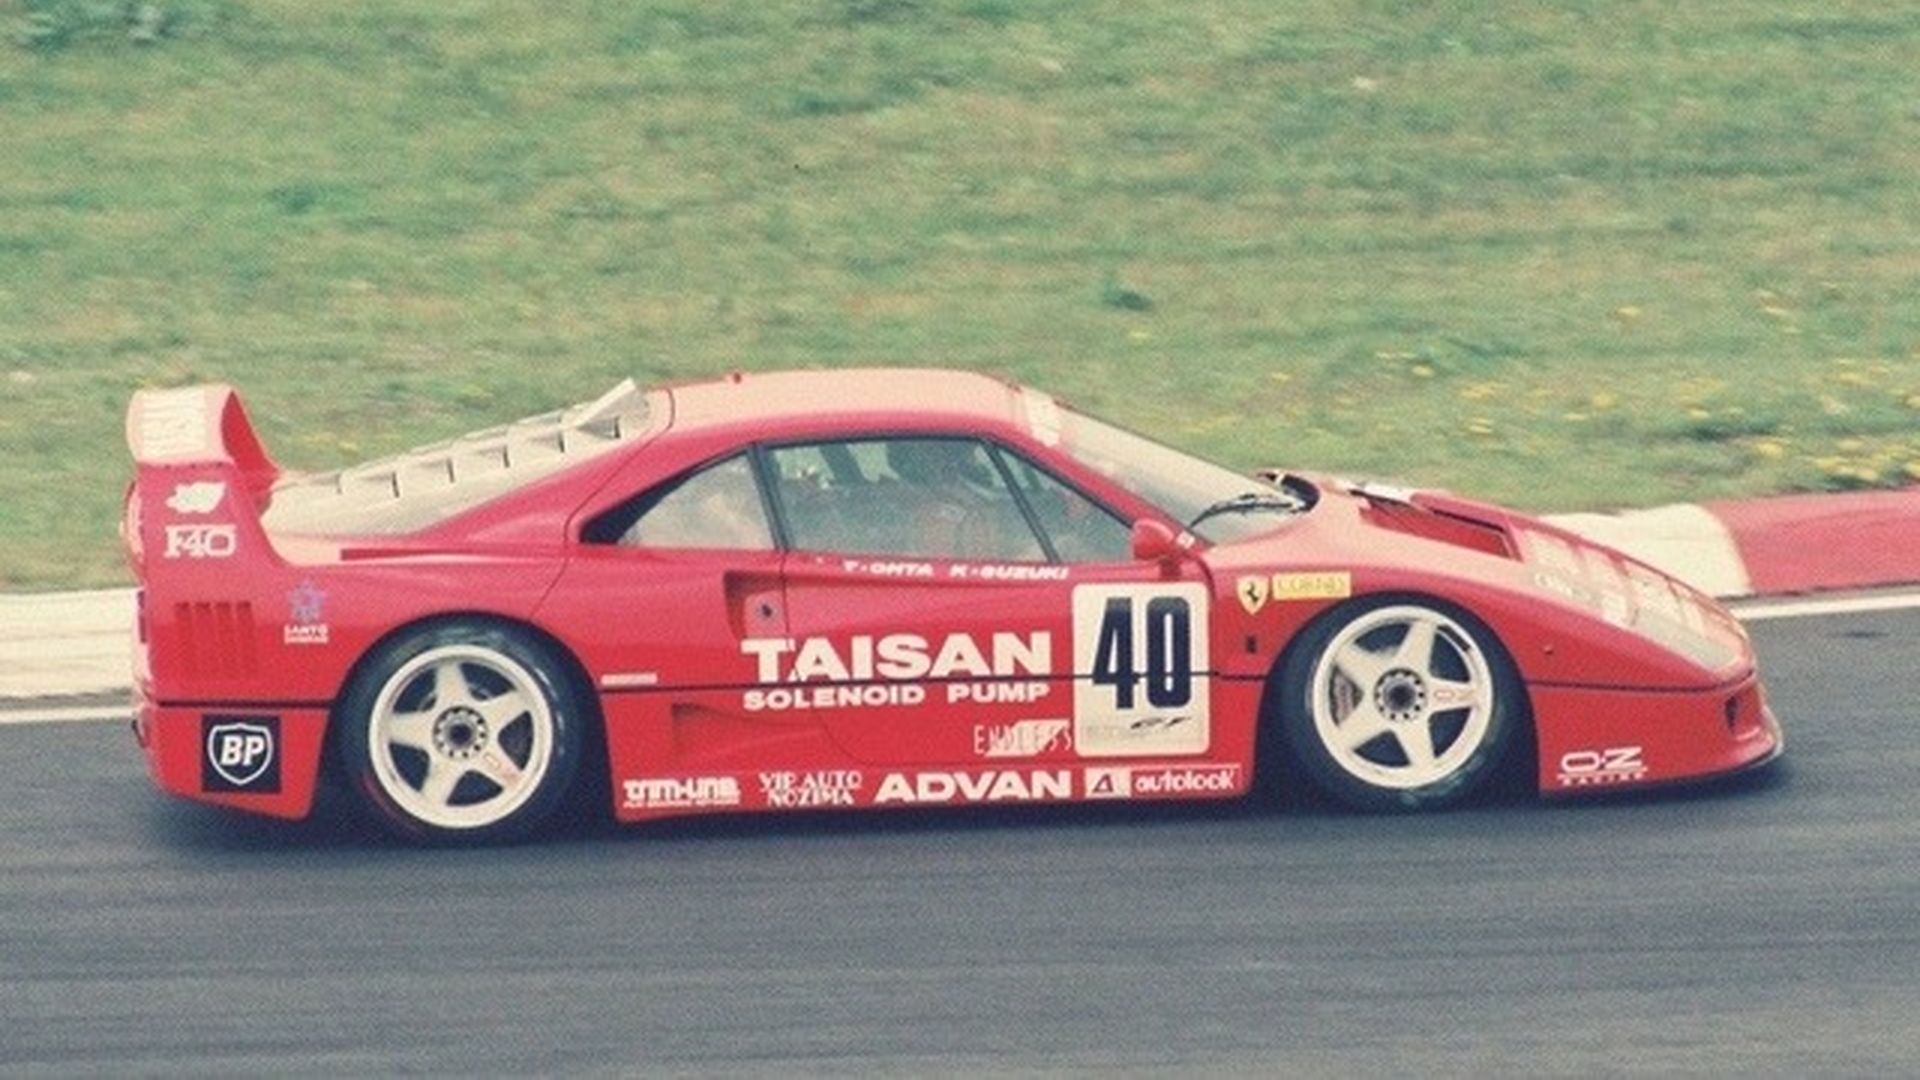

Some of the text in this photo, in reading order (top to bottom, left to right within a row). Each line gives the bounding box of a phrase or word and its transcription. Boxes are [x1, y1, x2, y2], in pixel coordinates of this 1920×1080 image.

[164, 523, 236, 559] F40
[741, 631, 1051, 683] TAISAN
[1092, 596, 1191, 709] 40
[743, 682, 1049, 711] SOLENOID PUMP
[221, 735, 265, 766] BP
[802, 771, 863, 789] AUTO
[875, 771, 1072, 801] ADVAN
